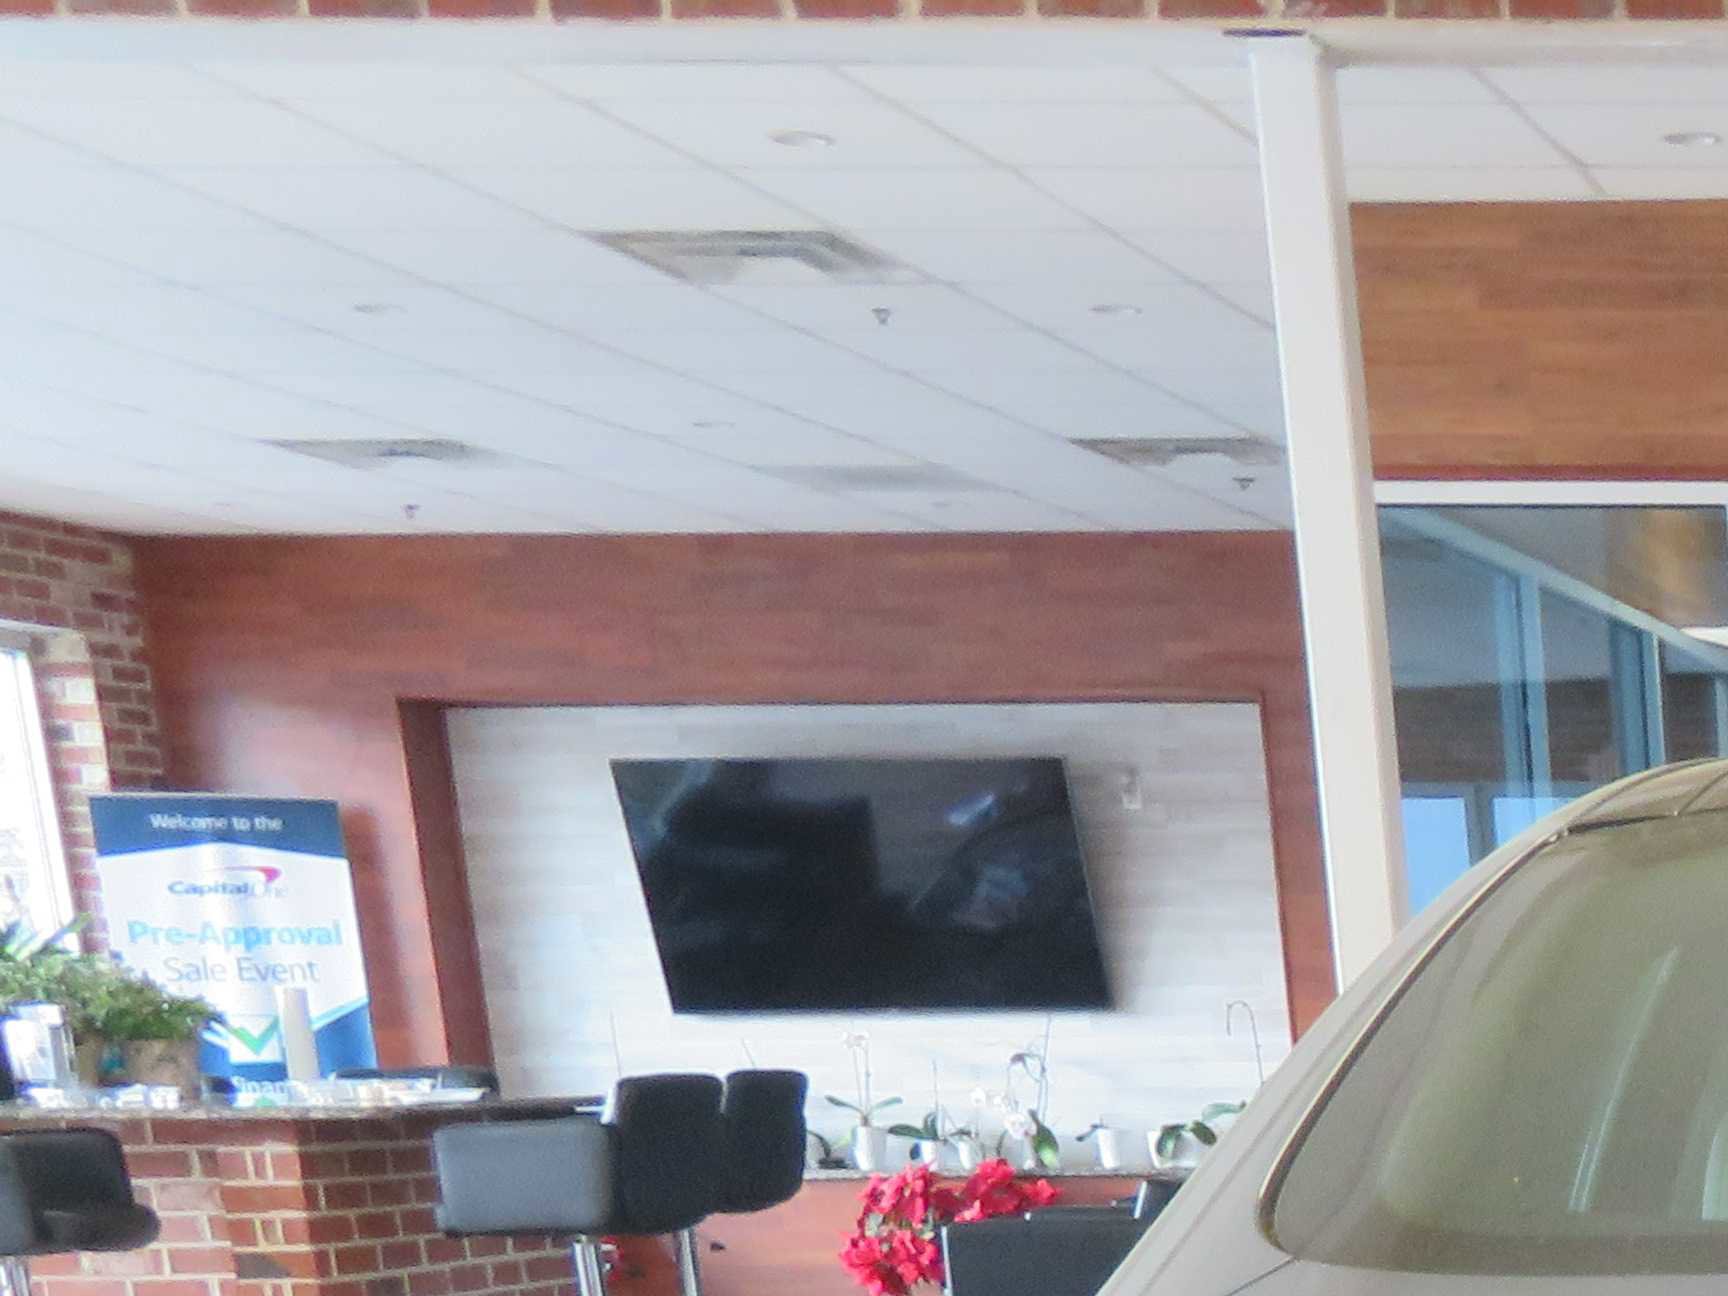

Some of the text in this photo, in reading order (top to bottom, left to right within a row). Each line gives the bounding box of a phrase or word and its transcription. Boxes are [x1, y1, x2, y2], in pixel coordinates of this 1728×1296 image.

[150, 812, 283, 831] Welcome to the
[128, 920, 342, 950] Pre-Approval
[163, 956, 322, 983] Sale Event
